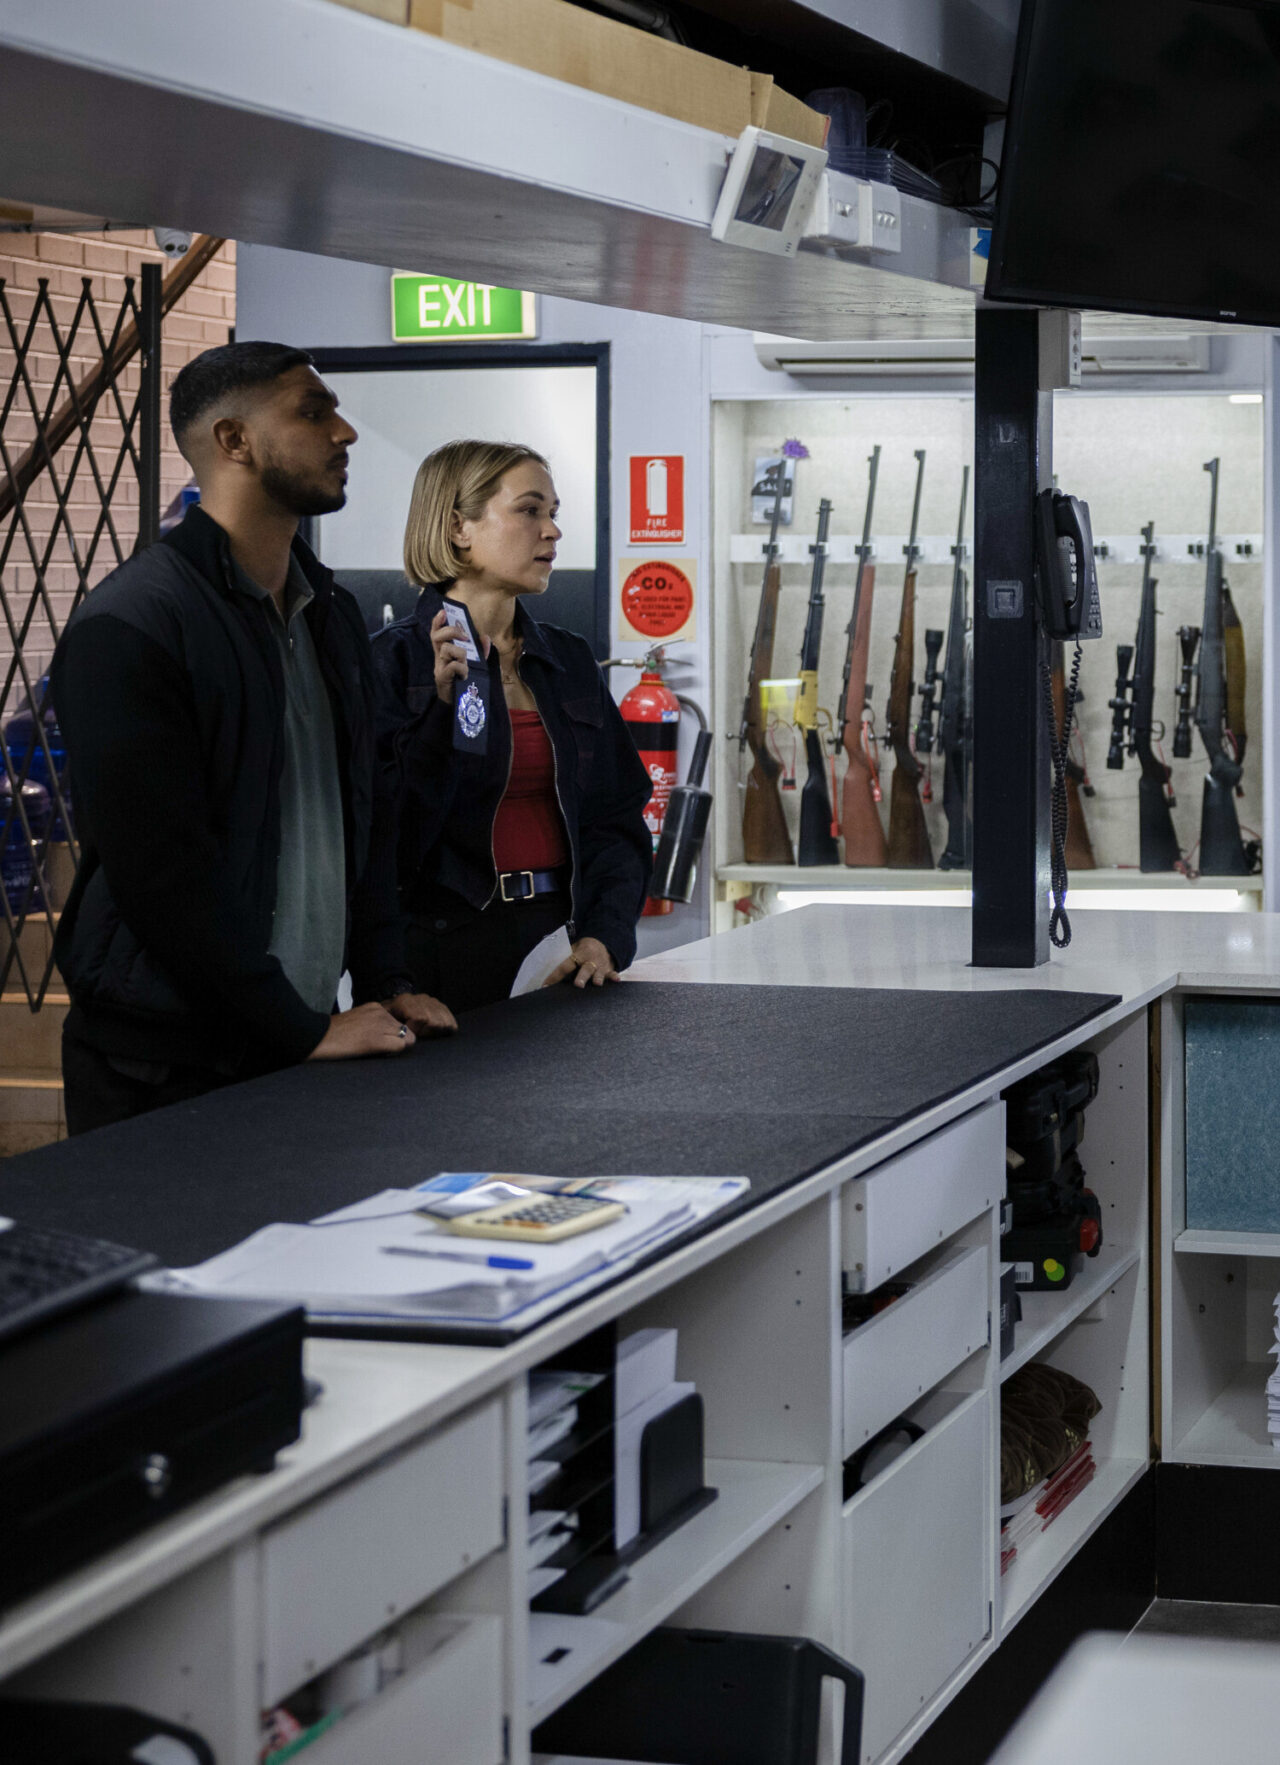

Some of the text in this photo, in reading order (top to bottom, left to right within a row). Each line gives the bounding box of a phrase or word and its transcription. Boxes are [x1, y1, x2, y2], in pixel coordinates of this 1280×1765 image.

[418, 283, 497, 328] EXIT
[647, 518, 667, 527] FIRE
[632, 530, 682, 538] EXTINGUISHER
